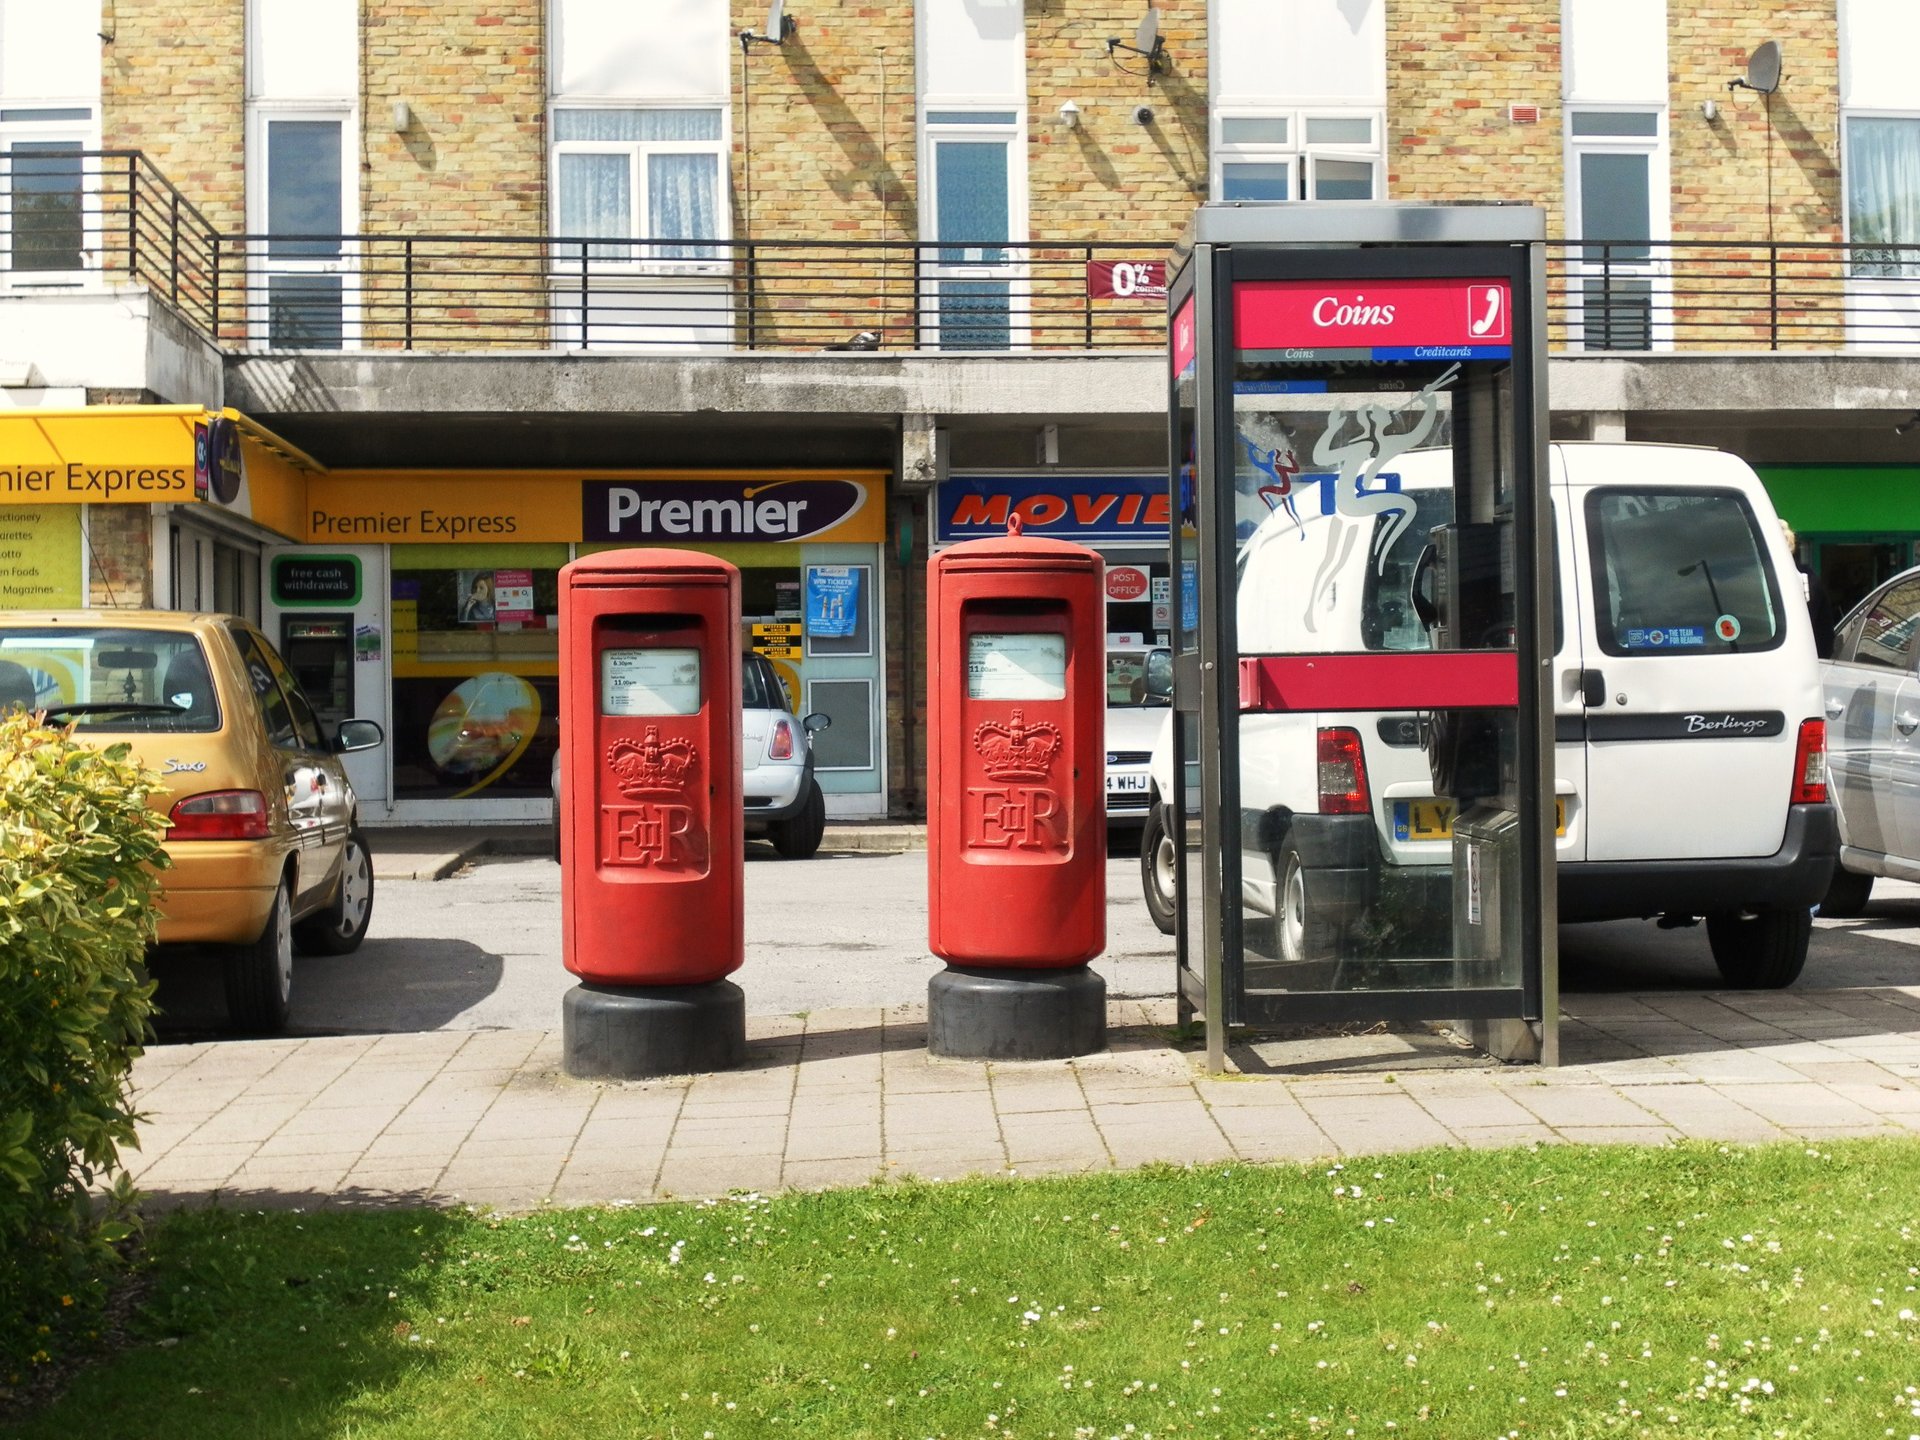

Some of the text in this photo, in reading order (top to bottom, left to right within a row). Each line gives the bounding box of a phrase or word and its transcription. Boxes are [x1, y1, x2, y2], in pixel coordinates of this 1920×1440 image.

[1312, 294, 1396, 326] Coins
[1285, 347, 1315, 359] Coins
[1414, 345, 1472, 358] Creditcards
[67, 463, 186, 498] Express
[608, 487, 807, 534] Premier
[312, 510, 517, 539] Premier Express
[12, 566, 39, 576] Foods
[291, 567, 341, 578] free cash
[1113, 573, 1137, 582] POST
[3, 585, 54, 596] Magazines
[284, 580, 349, 590] withdrawals
[1109, 586, 1141, 594] OFFICE
[1684, 714, 1768, 734] Berlingo
[161, 758, 207, 775] Saxo
[1117, 775, 1146, 790] WHJ
